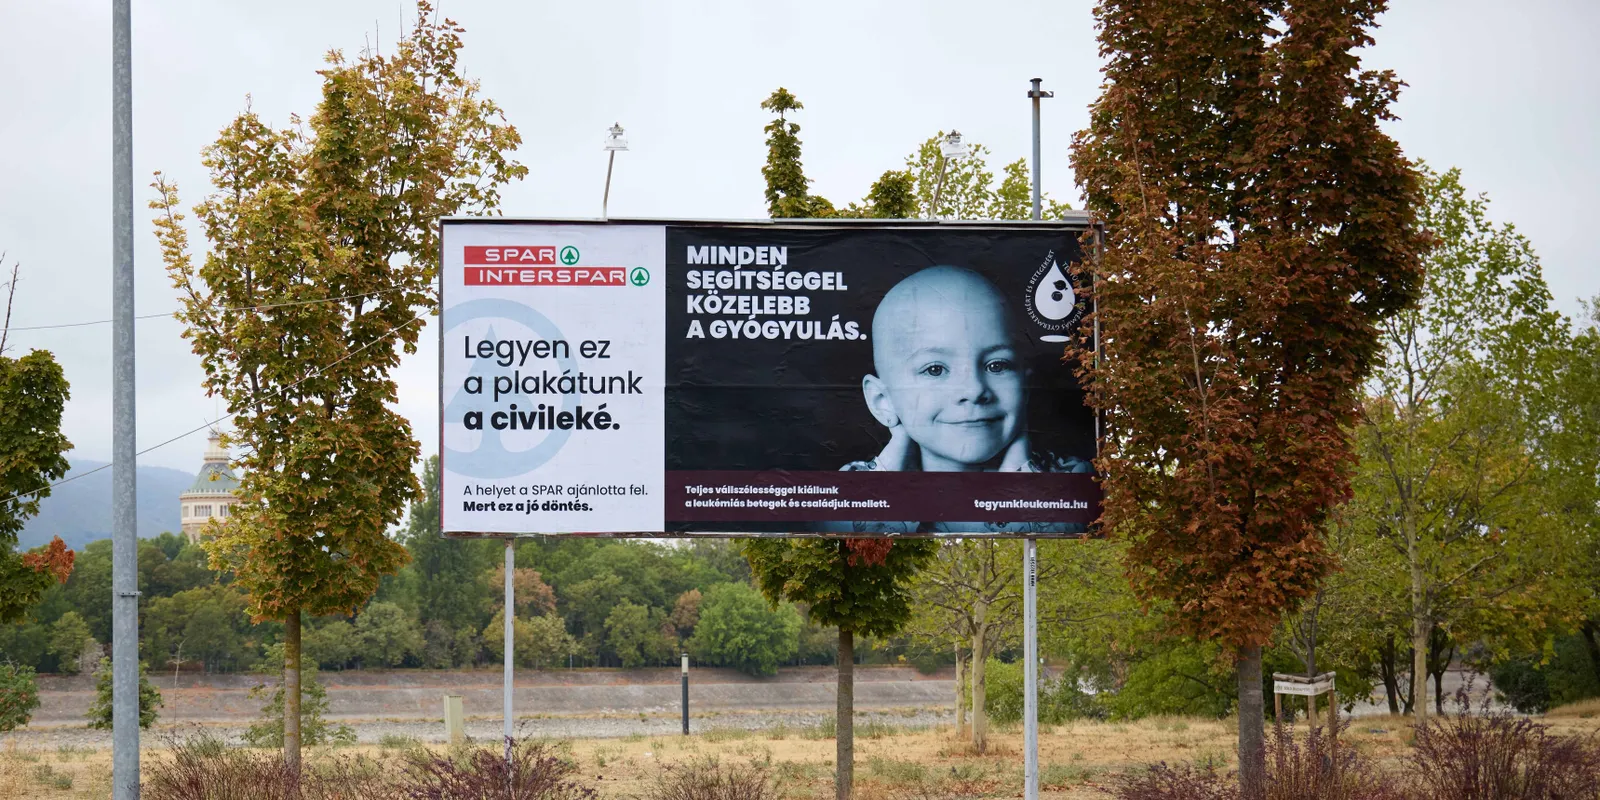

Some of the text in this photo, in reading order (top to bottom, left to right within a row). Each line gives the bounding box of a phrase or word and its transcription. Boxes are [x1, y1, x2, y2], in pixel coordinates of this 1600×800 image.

[485, 248, 554, 262] SPAR
[687, 245, 787, 265] MINDEN
[479, 269, 625, 283] INTERSPAR
[686, 264, 848, 291] SEGÍTSÉGGEL
[686, 289, 811, 315] KÖZELEBB
[685, 314, 867, 341] A GYÓGYULÁS.
[464, 335, 611, 367] Legyen ez
[463, 368, 643, 402] a plakátunk
[463, 402, 621, 431] a civileké.
[463, 484, 648, 499] A helyet a SPAR ajánlotta fel.
[685, 485, 839, 497] Teljes vállszélességgel kiállunk
[463, 500, 593, 515] Mert ez a jó döntés.
[685, 499, 890, 510] a leukémiás betegek és családjuk mellett.
[974, 499, 1088, 511] tegyunkleukemia.hu
